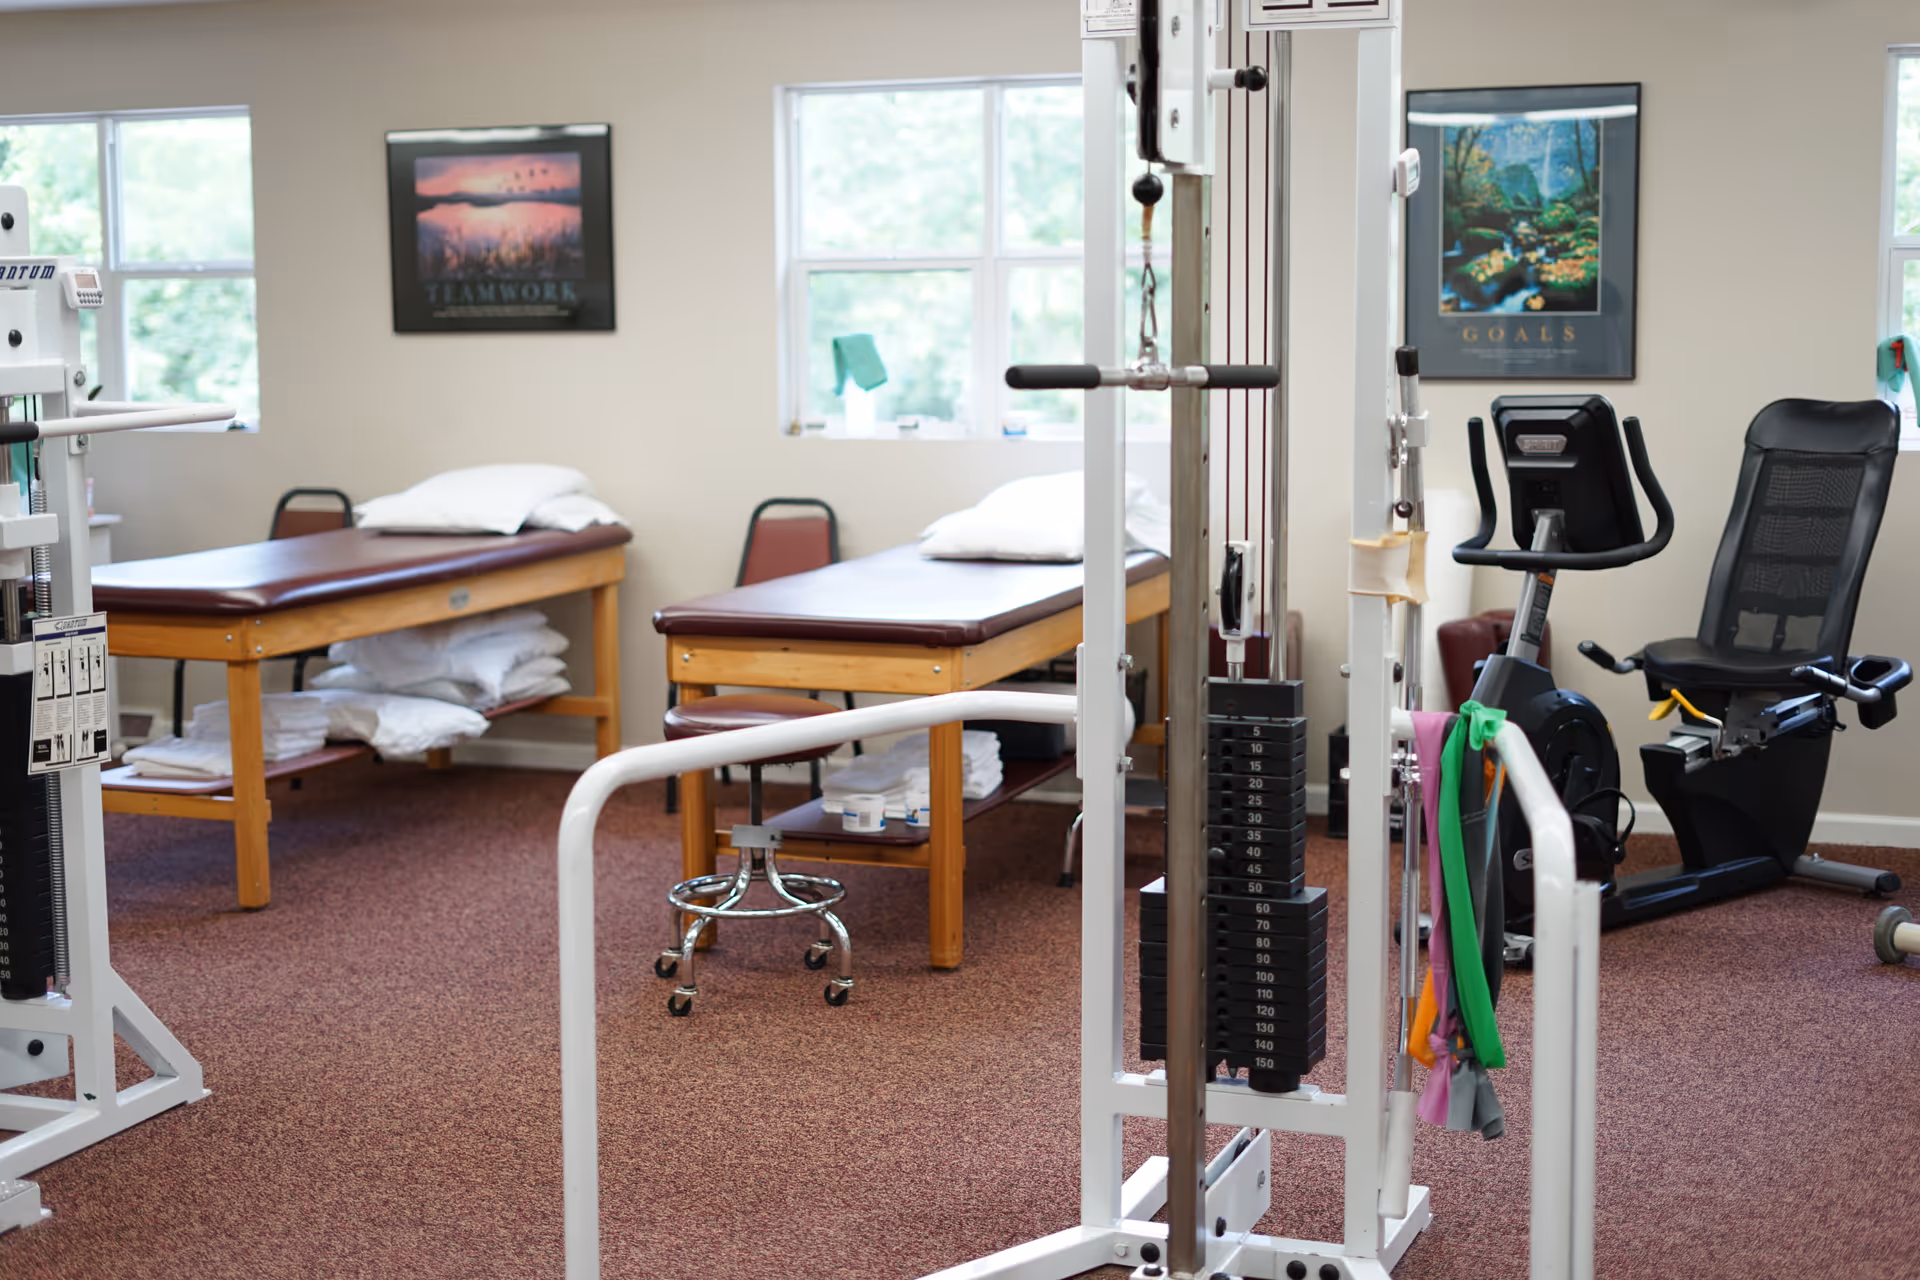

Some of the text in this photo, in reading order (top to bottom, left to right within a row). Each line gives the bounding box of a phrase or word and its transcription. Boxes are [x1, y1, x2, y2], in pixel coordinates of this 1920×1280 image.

[425, 281, 578, 304] TEAMWORK
[1462, 326, 1576, 342] GOALS
[1253, 726, 1261, 737] 5
[1251, 743, 1263, 753] 10
[1250, 761, 1262, 772] 15
[1249, 778, 1263, 789] 20
[1248, 795, 1262, 806] 25
[1248, 812, 1262, 824] 30
[1247, 830, 1261, 841] 35
[1246, 846, 1261, 857] 40
[1247, 864, 1262, 874] 45
[1248, 882, 1263, 893] 50
[1256, 903, 1270, 913] 60
[1256, 919, 1270, 931] 70
[1256, 937, 1270, 948] 80
[1256, 953, 1270, 964] 90
[1256, 971, 1274, 983] 100
[1256, 988, 1273, 999] 110
[1256, 1004, 1275, 1017] 120
[1255, 1022, 1275, 1034] 130
[1255, 1039, 1274, 1051] 140
[1255, 1057, 1274, 1069] 150
